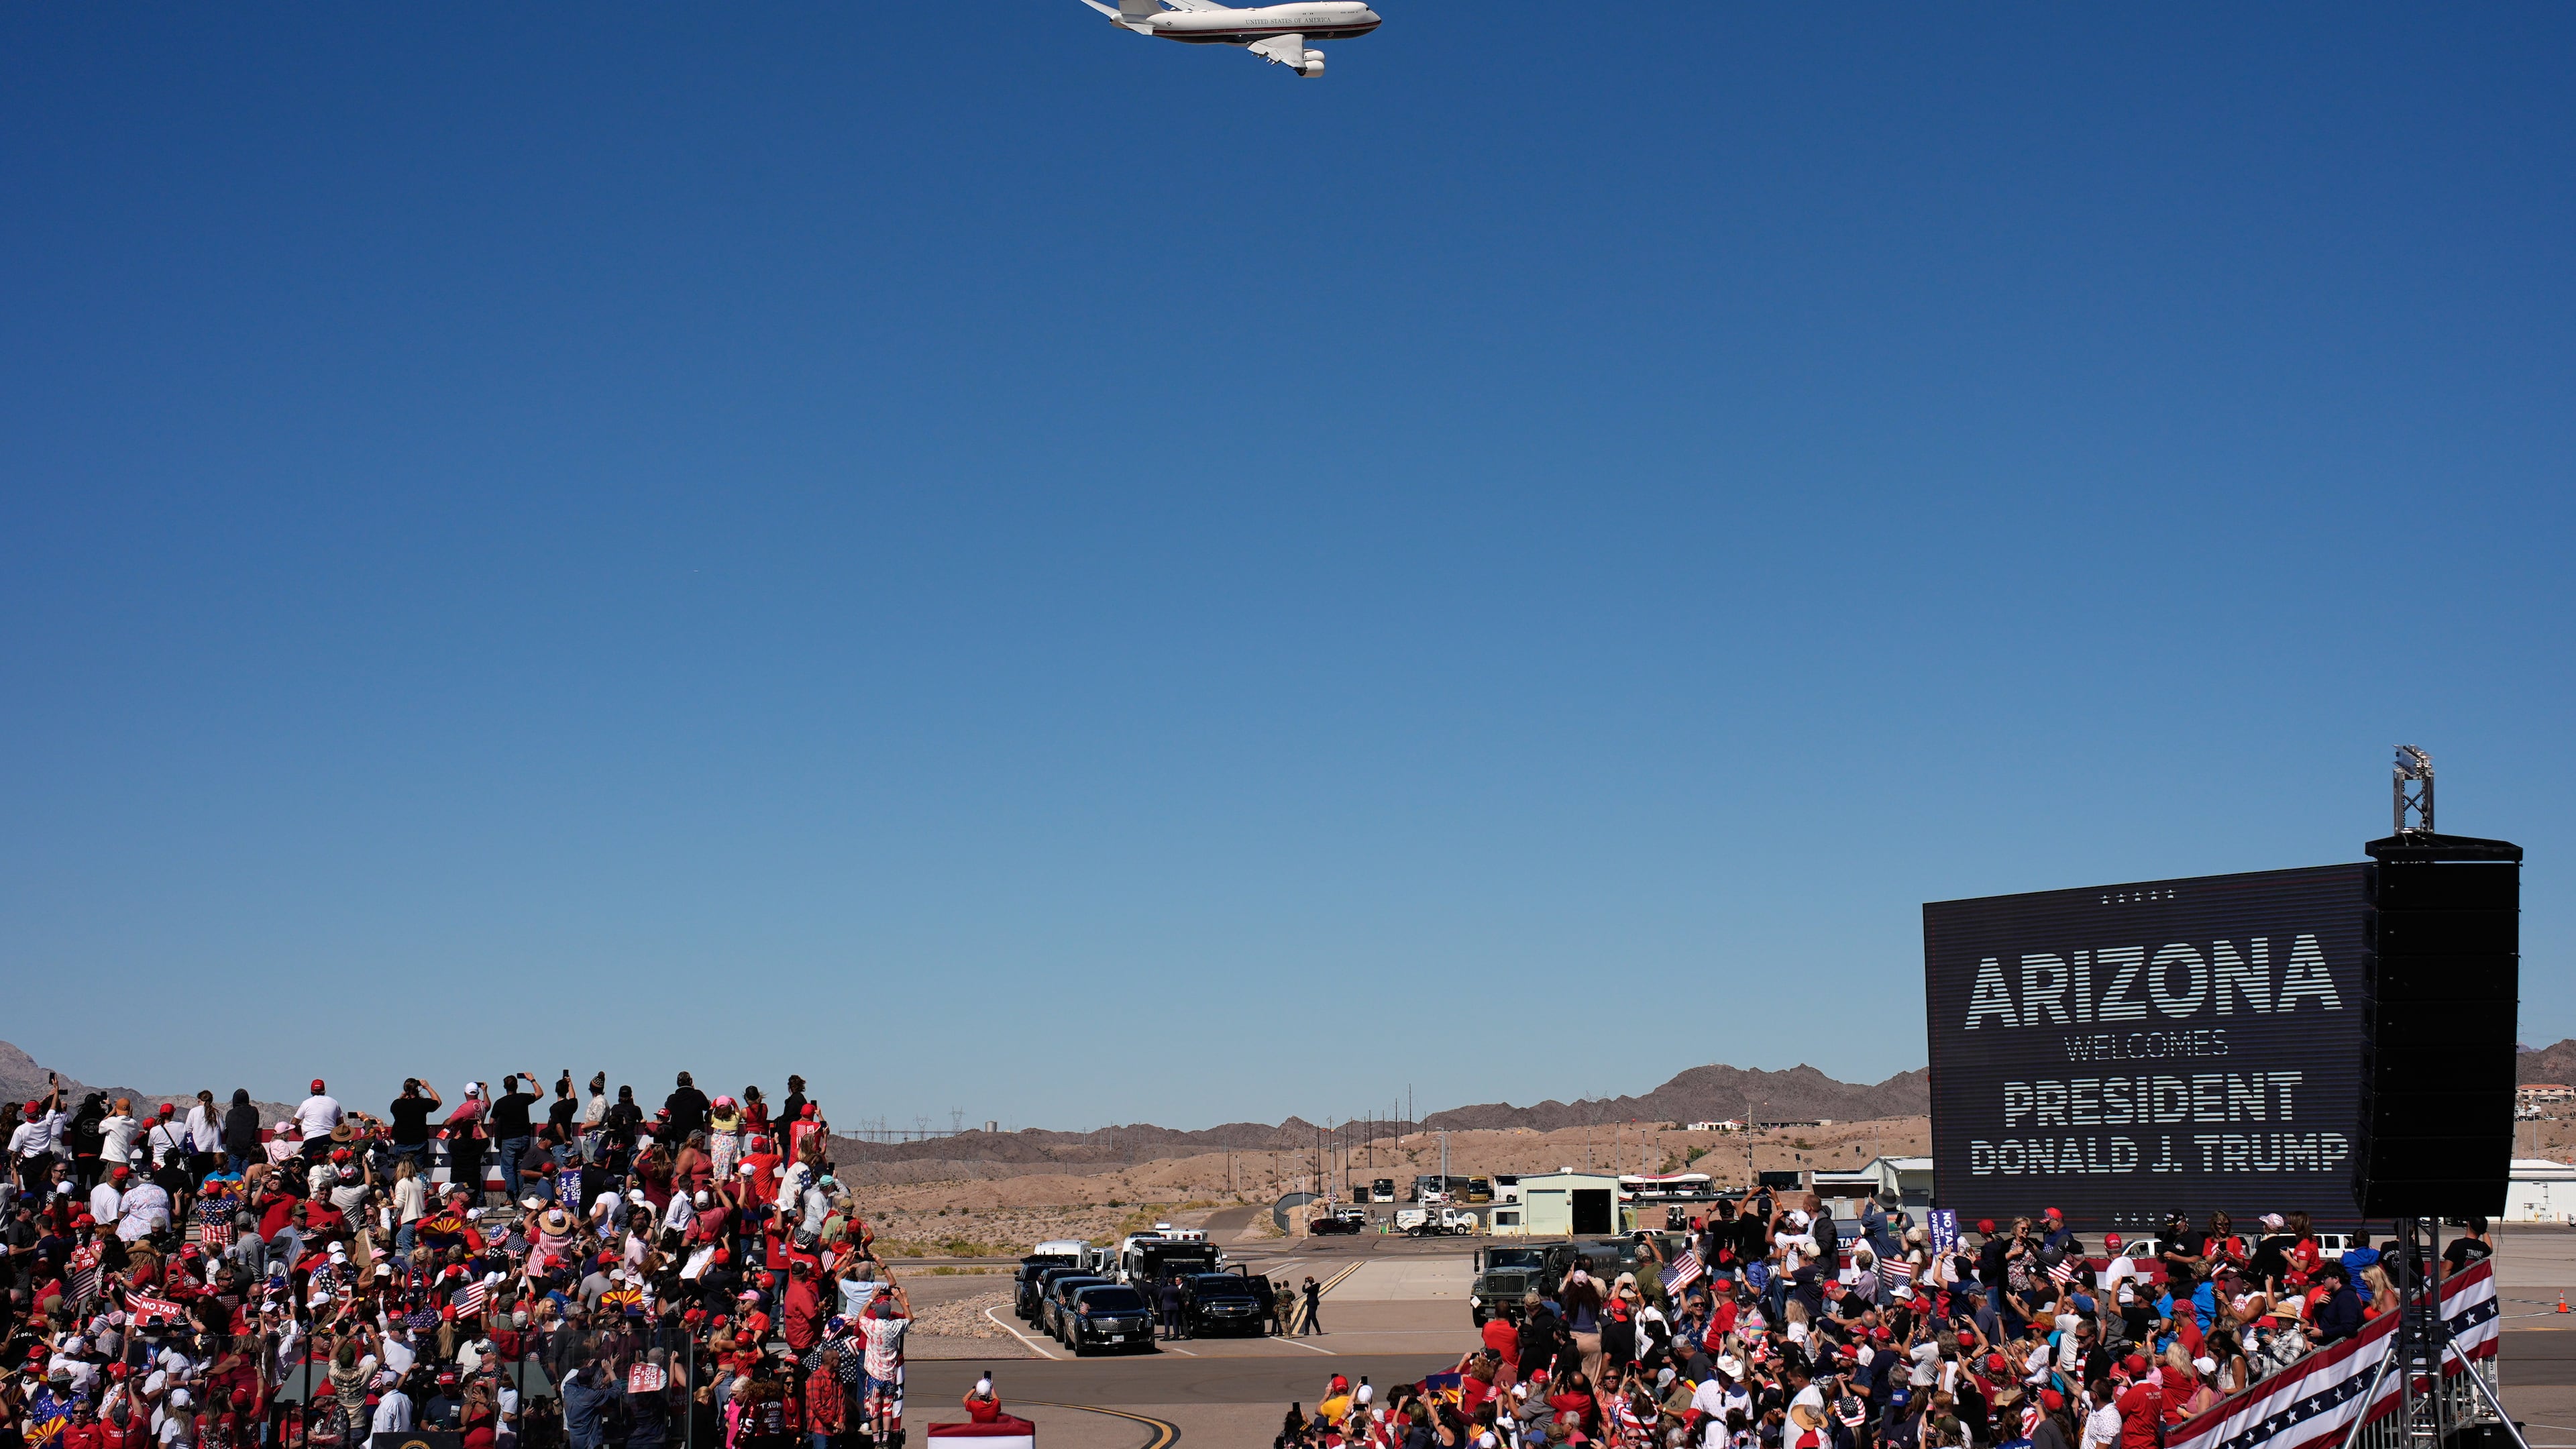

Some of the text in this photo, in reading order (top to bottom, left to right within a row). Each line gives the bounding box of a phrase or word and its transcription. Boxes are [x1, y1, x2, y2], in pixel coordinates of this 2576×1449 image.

[1965, 934, 2342, 1030] ARIZONA
[2065, 1030, 2229, 1061] WELCOMES
[2004, 1071, 2302, 1128] PRESIDENT
[1971, 1133, 2349, 1175] DONALD J. TRUMP
[563, 1191, 569, 1201] NO
[1943, 1212, 1952, 1228] NO
[1931, 1212, 1941, 1252] OVERTIME
[1939, 1227, 1945, 1236] ON
[76, 1247, 85, 1255] NO
[81, 1258, 95, 1267] TIPS
[142, 1301, 178, 1315] NO TAX
[633, 1375, 641, 1386] NO
